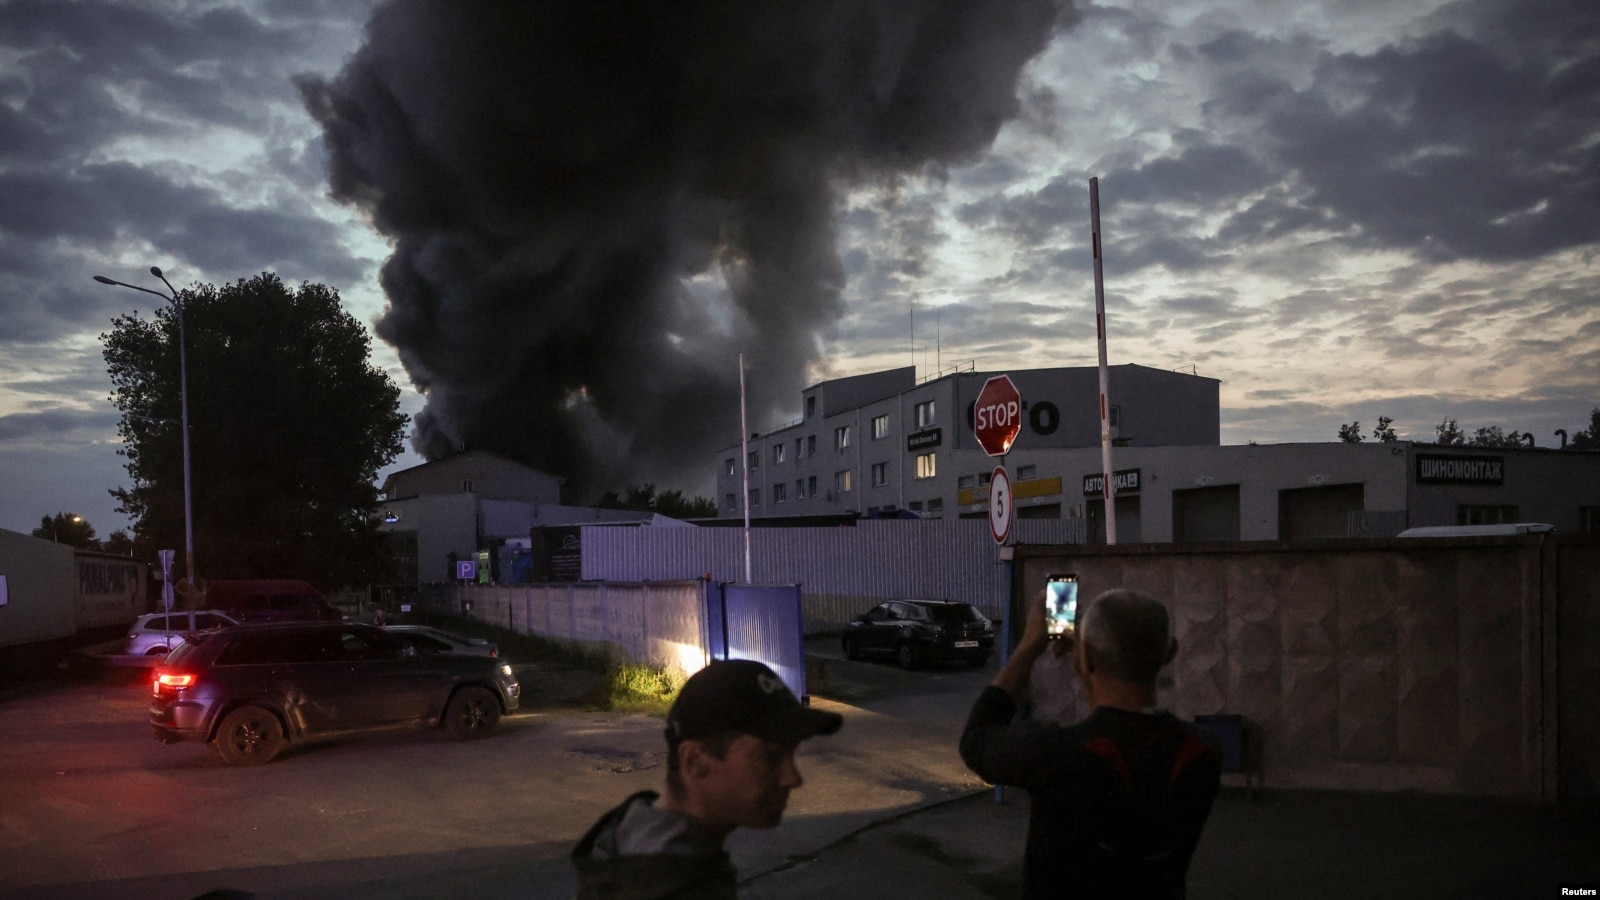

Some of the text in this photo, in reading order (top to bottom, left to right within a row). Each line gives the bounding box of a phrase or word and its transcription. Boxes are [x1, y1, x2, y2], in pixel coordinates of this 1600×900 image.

[977, 401, 1018, 431] STOP
[1421, 459, 1502, 479] ШИНОМОНТАЖ
[1084, 473, 1127, 492] АВТОЙКА
[997, 491, 1004, 519] 5
[461, 563, 471, 577] P
